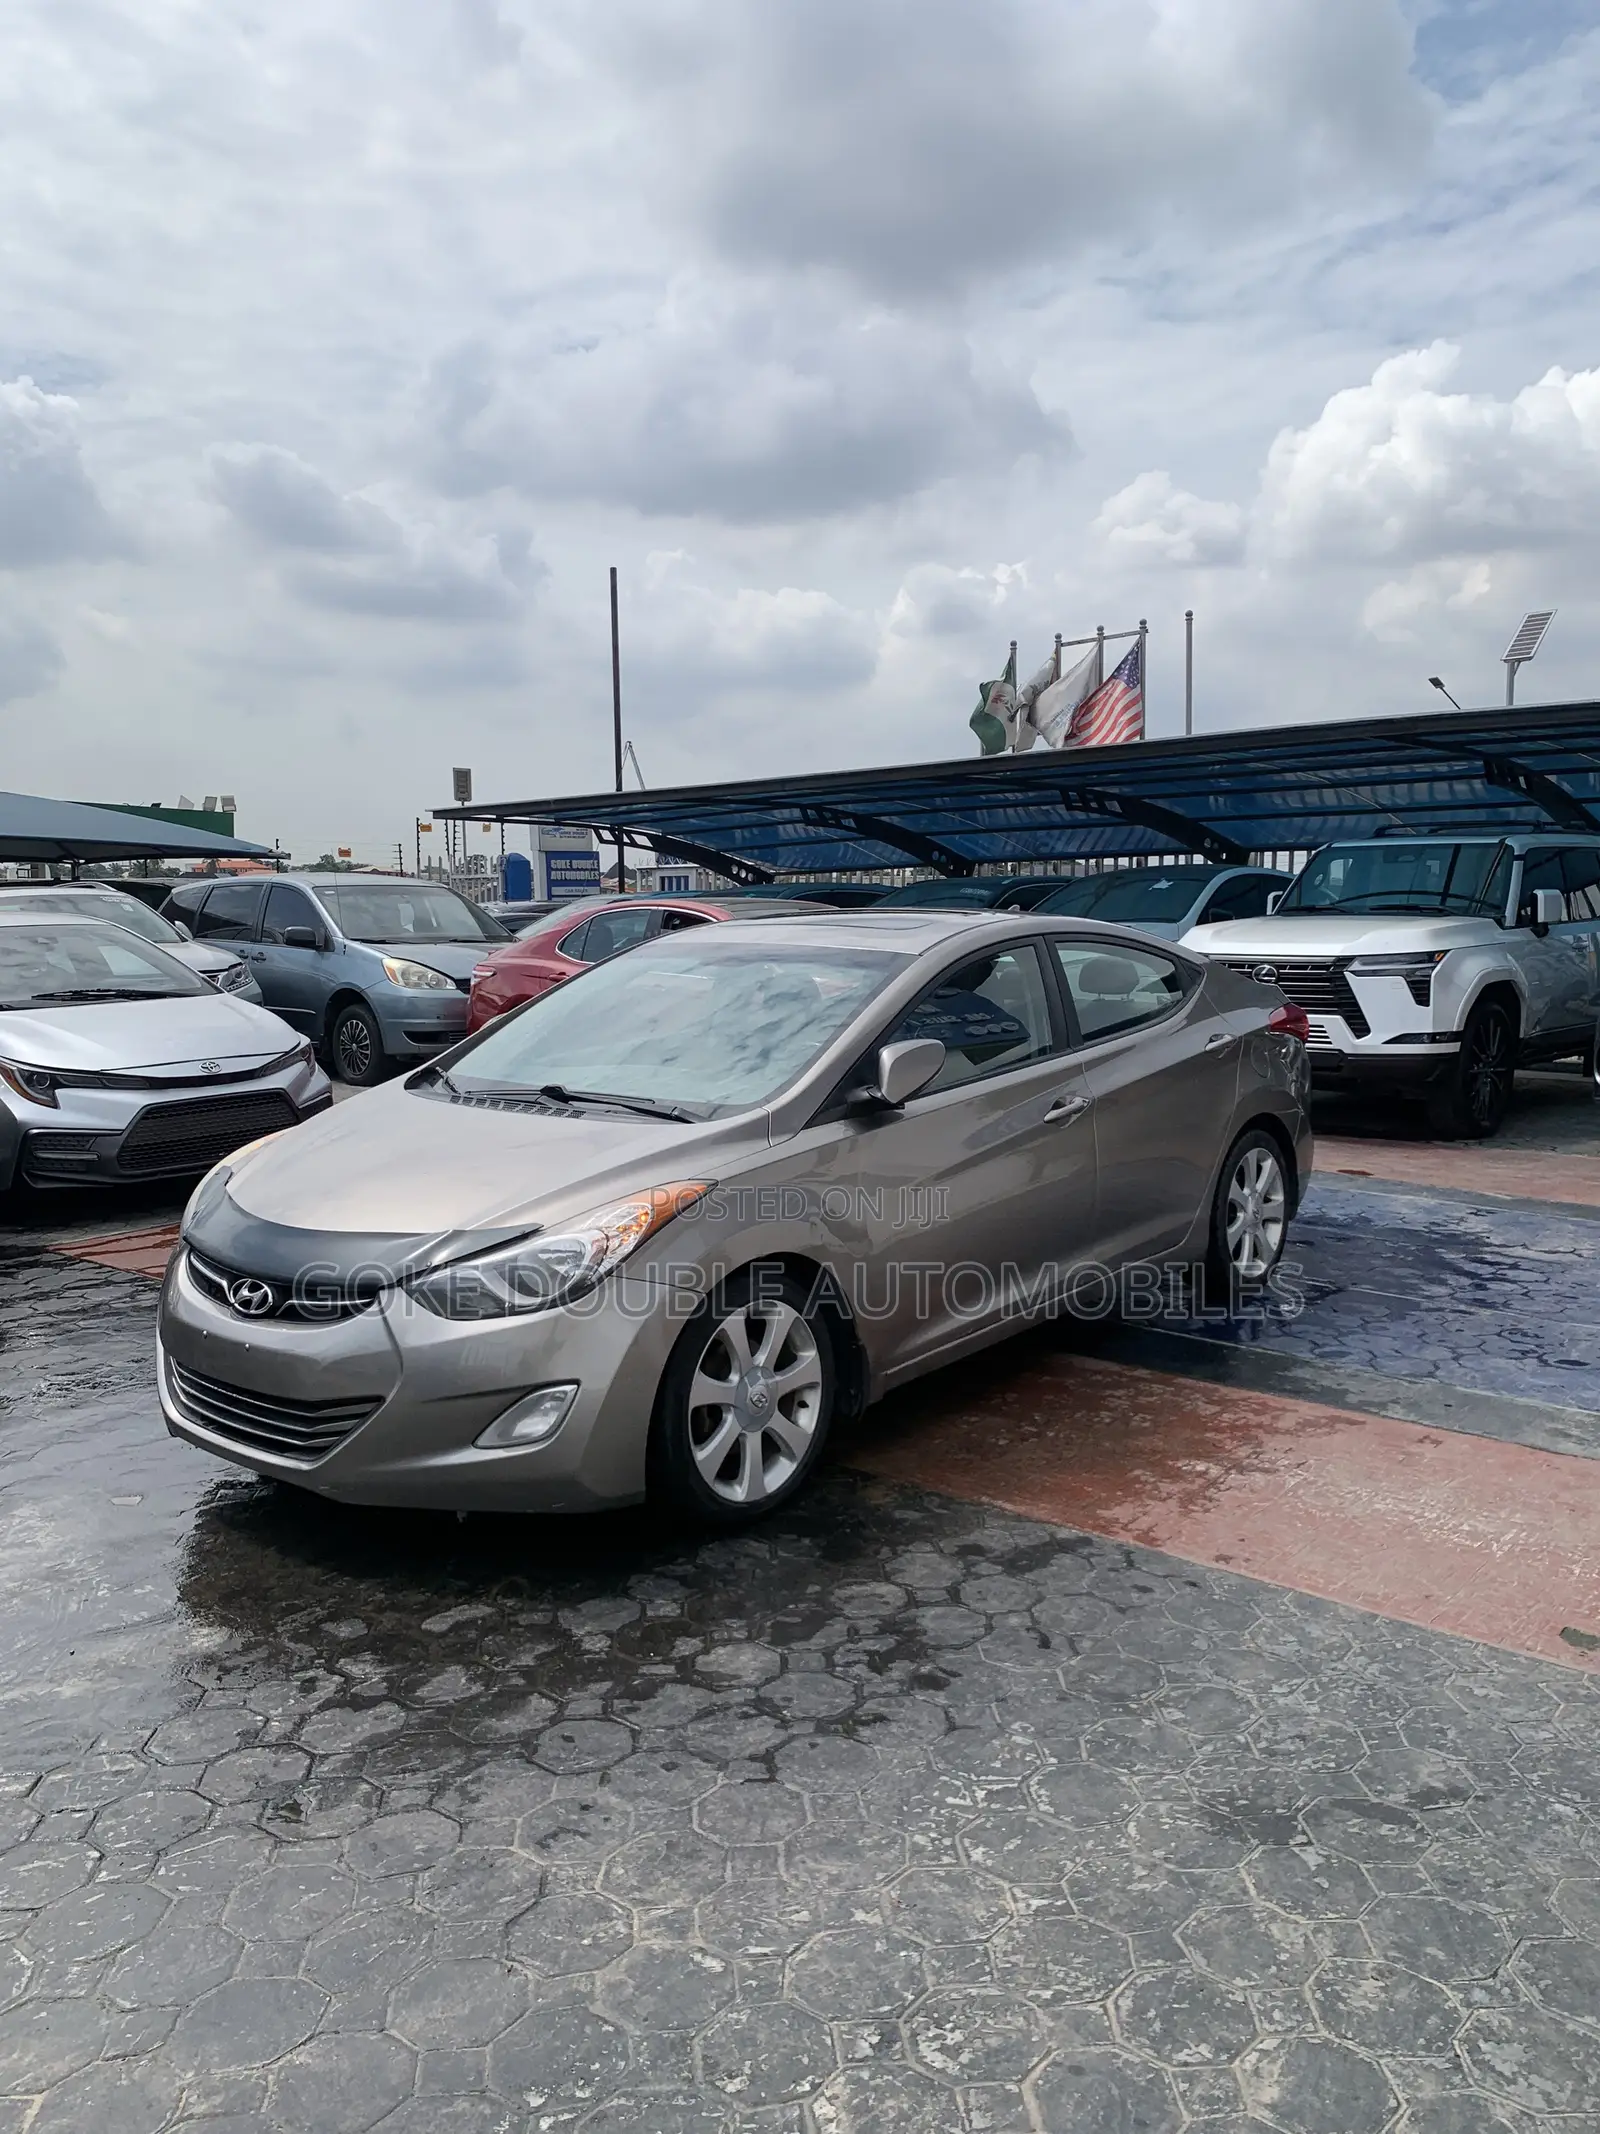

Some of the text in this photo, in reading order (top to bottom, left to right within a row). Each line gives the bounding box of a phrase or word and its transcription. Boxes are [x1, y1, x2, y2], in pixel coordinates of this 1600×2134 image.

[551, 860, 598, 869] GOKE DOUBLE
[551, 870, 600, 880] AUTOMOBILES
